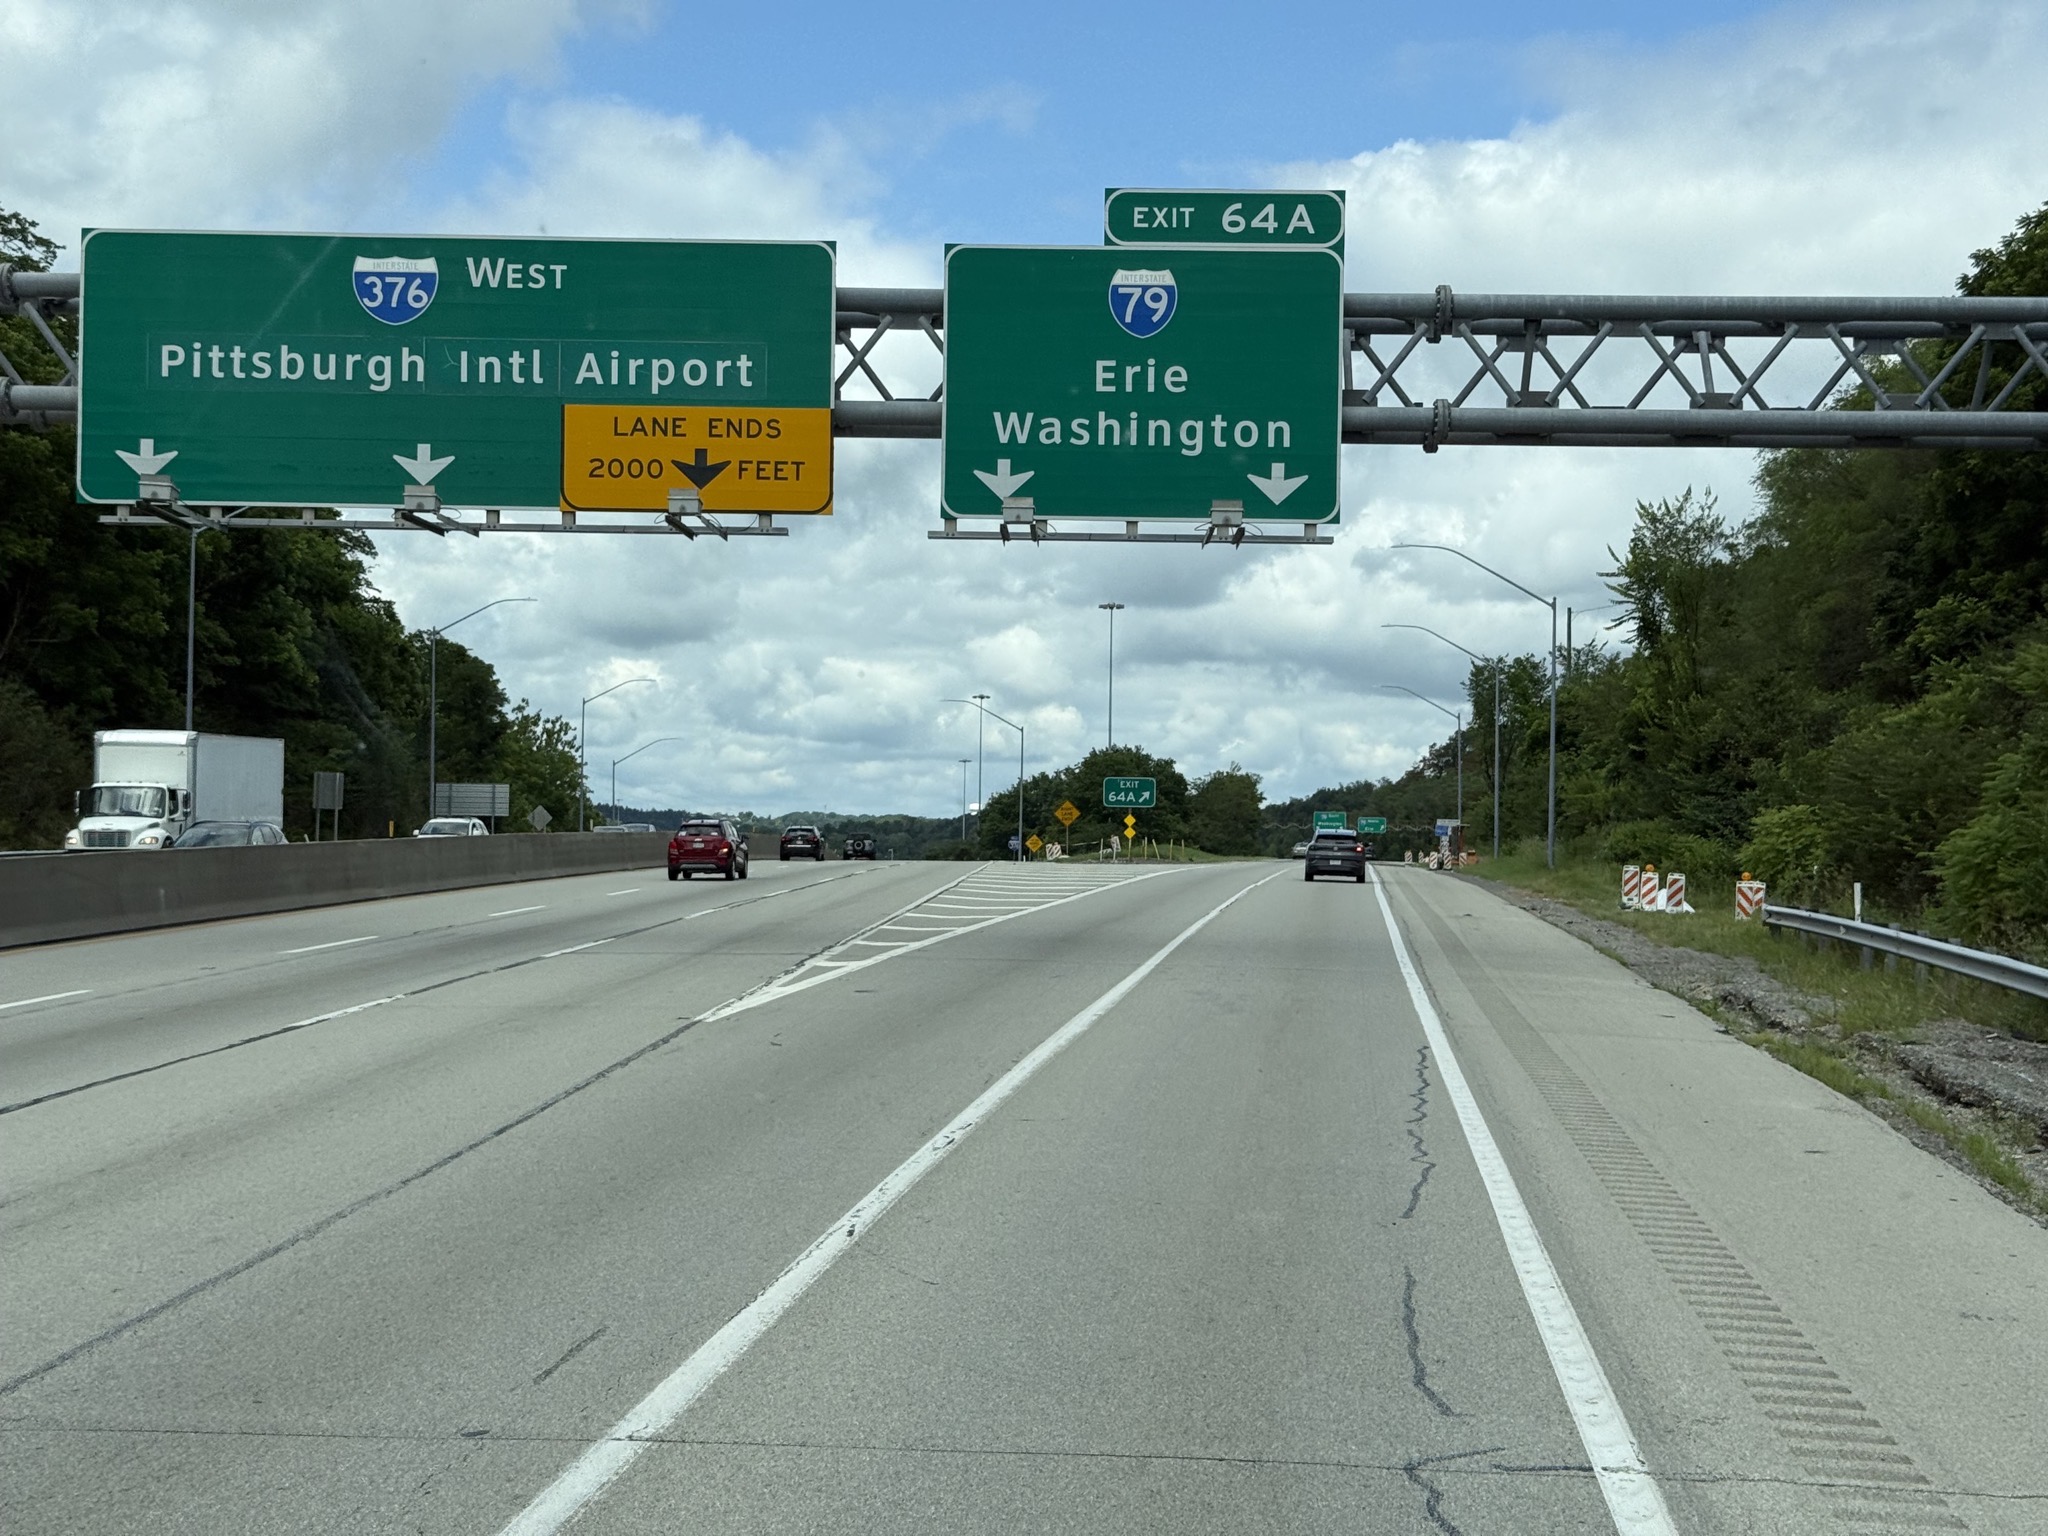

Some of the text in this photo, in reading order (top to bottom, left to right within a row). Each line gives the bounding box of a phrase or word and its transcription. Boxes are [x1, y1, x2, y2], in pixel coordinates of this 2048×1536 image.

[1132, 202, 1316, 235] EXIT 64A
[373, 261, 419, 271] INTERSTATE
[466, 256, 568, 290] WEST
[1121, 273, 1167, 283] INTERSTATE
[362, 275, 430, 310] 376
[1117, 286, 1169, 324] 79
[160, 341, 754, 396] Pittsburgh Intl Airport
[1095, 358, 1189, 394] Erie
[613, 417, 782, 440] LANE ENDS
[992, 411, 1292, 458] Washington
[589, 457, 807, 482] 2000 FEET
[1108, 791, 1136, 802] 64A
[1120, 780, 1140, 788] EXIT
